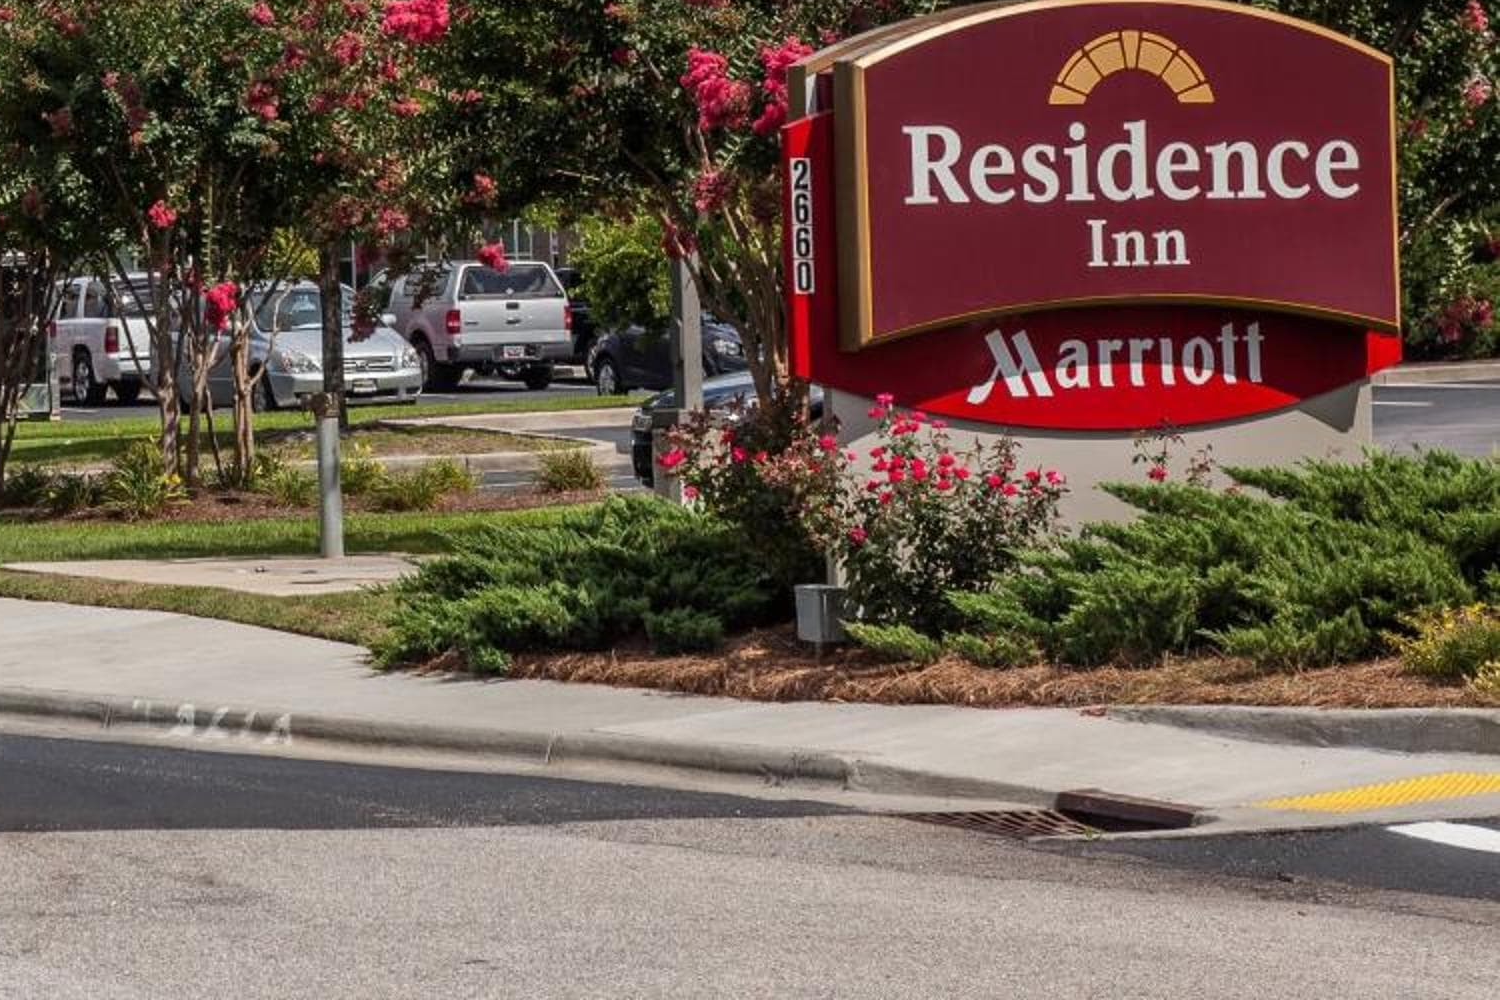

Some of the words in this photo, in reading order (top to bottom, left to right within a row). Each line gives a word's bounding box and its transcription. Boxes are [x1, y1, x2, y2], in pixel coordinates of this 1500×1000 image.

[901, 119, 1360, 206] Residence
[792, 159, 812, 292] 2660
[1086, 218, 1191, 268] Inn
[966, 320, 1265, 405] Marriott
